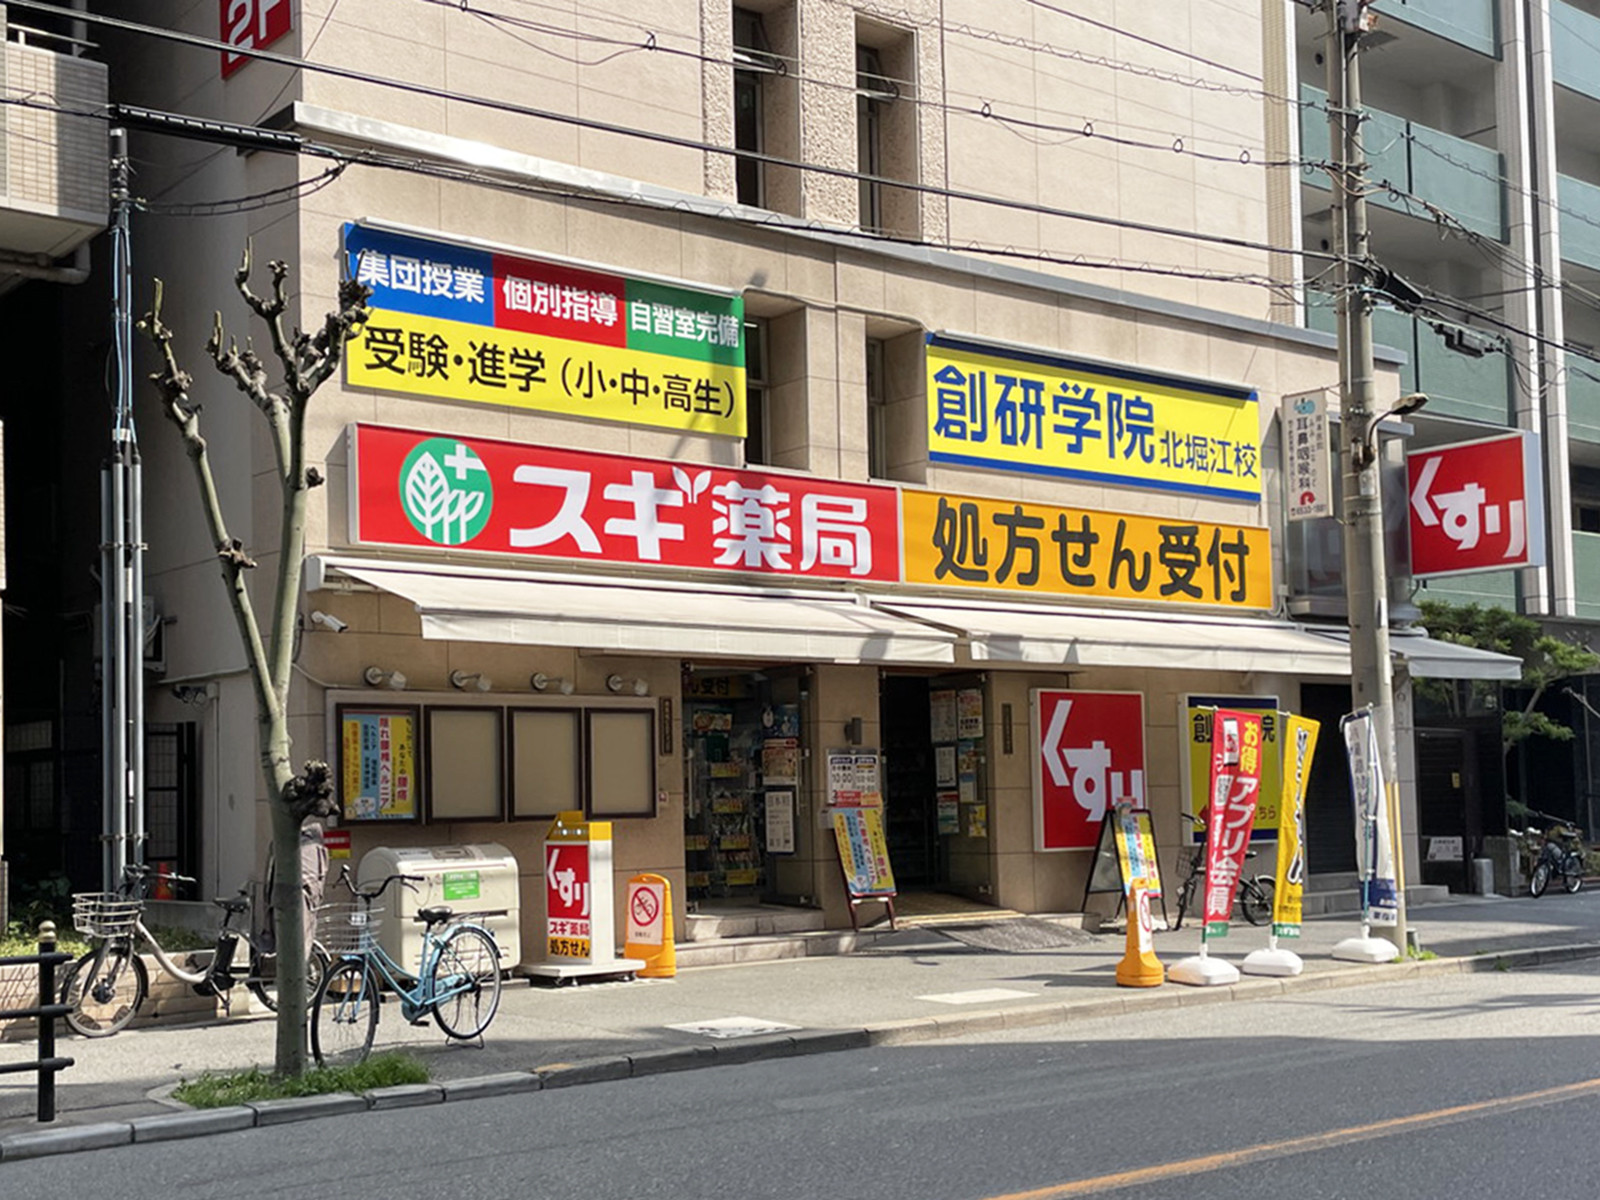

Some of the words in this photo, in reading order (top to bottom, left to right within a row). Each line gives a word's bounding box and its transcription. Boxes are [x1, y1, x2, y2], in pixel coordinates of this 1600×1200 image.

[356, 249, 485, 304] 集団授業
[502, 275, 618, 327] 個別指導
[630, 300, 739, 348] 自習室完備
[932, 364, 1155, 464] 創研学院
[1159, 429, 1257, 479] 北堀江校
[509, 464, 872, 575] スギ薬局
[1411, 456, 1526, 559] くすり
[932, 497, 1250, 603] 処方せん受付
[1042, 699, 1145, 822] くすり
[548, 848, 590, 917] くすり
[549, 921, 590, 936] スギ薬局
[550, 939, 590, 957] 処方せん
